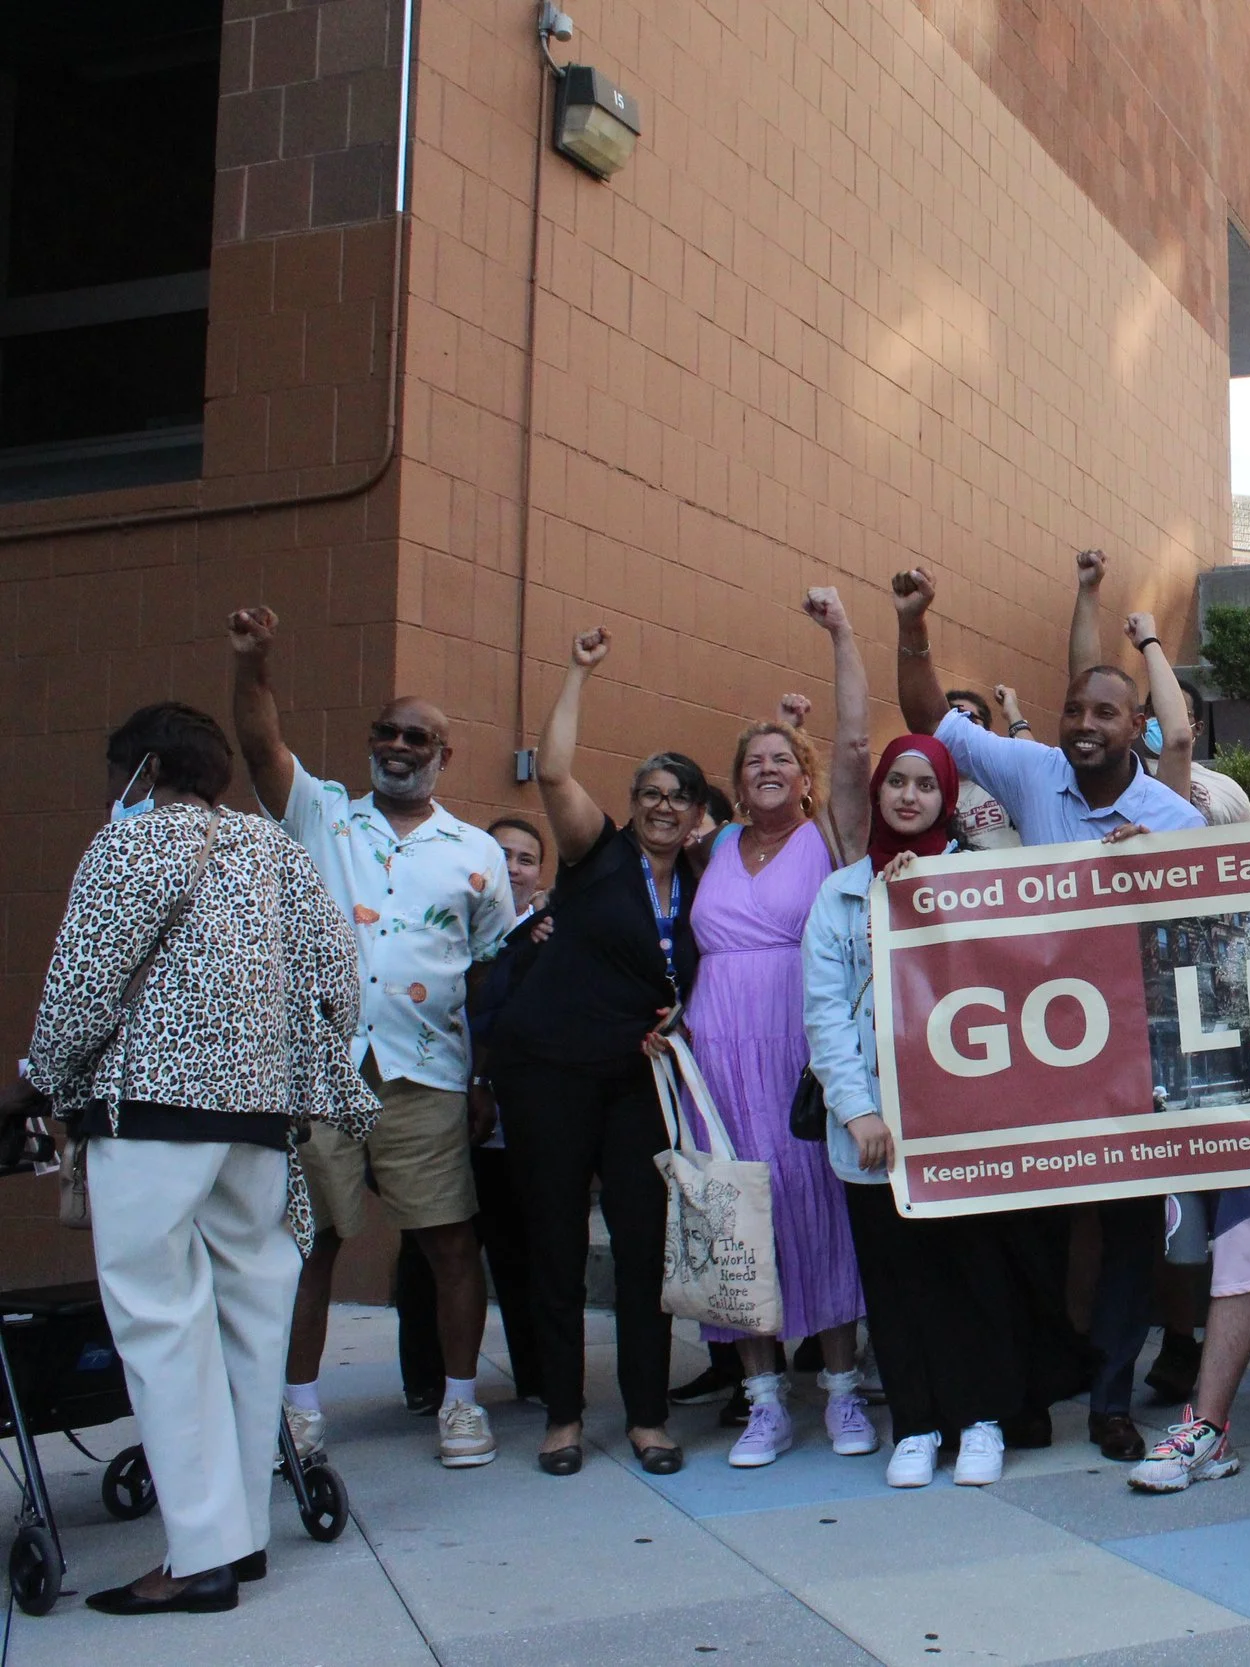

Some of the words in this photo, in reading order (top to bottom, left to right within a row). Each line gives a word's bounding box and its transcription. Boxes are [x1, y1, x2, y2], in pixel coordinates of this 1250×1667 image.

[614, 90, 624, 109] 15
[963, 808, 1002, 832] LES
[912, 879, 1004, 914] Good
[1017, 871, 1077, 903] Old
[1091, 863, 1204, 896] Lower
[926, 977, 1110, 1078] GO
[922, 1160, 1014, 1183] Keeping
[1021, 1150, 1097, 1173] People
[1103, 1147, 1124, 1164] in
[1130, 1140, 1182, 1162] their
[719, 1237, 744, 1251] The
[720, 1265, 756, 1281] Needs
[719, 1283, 748, 1296] More
